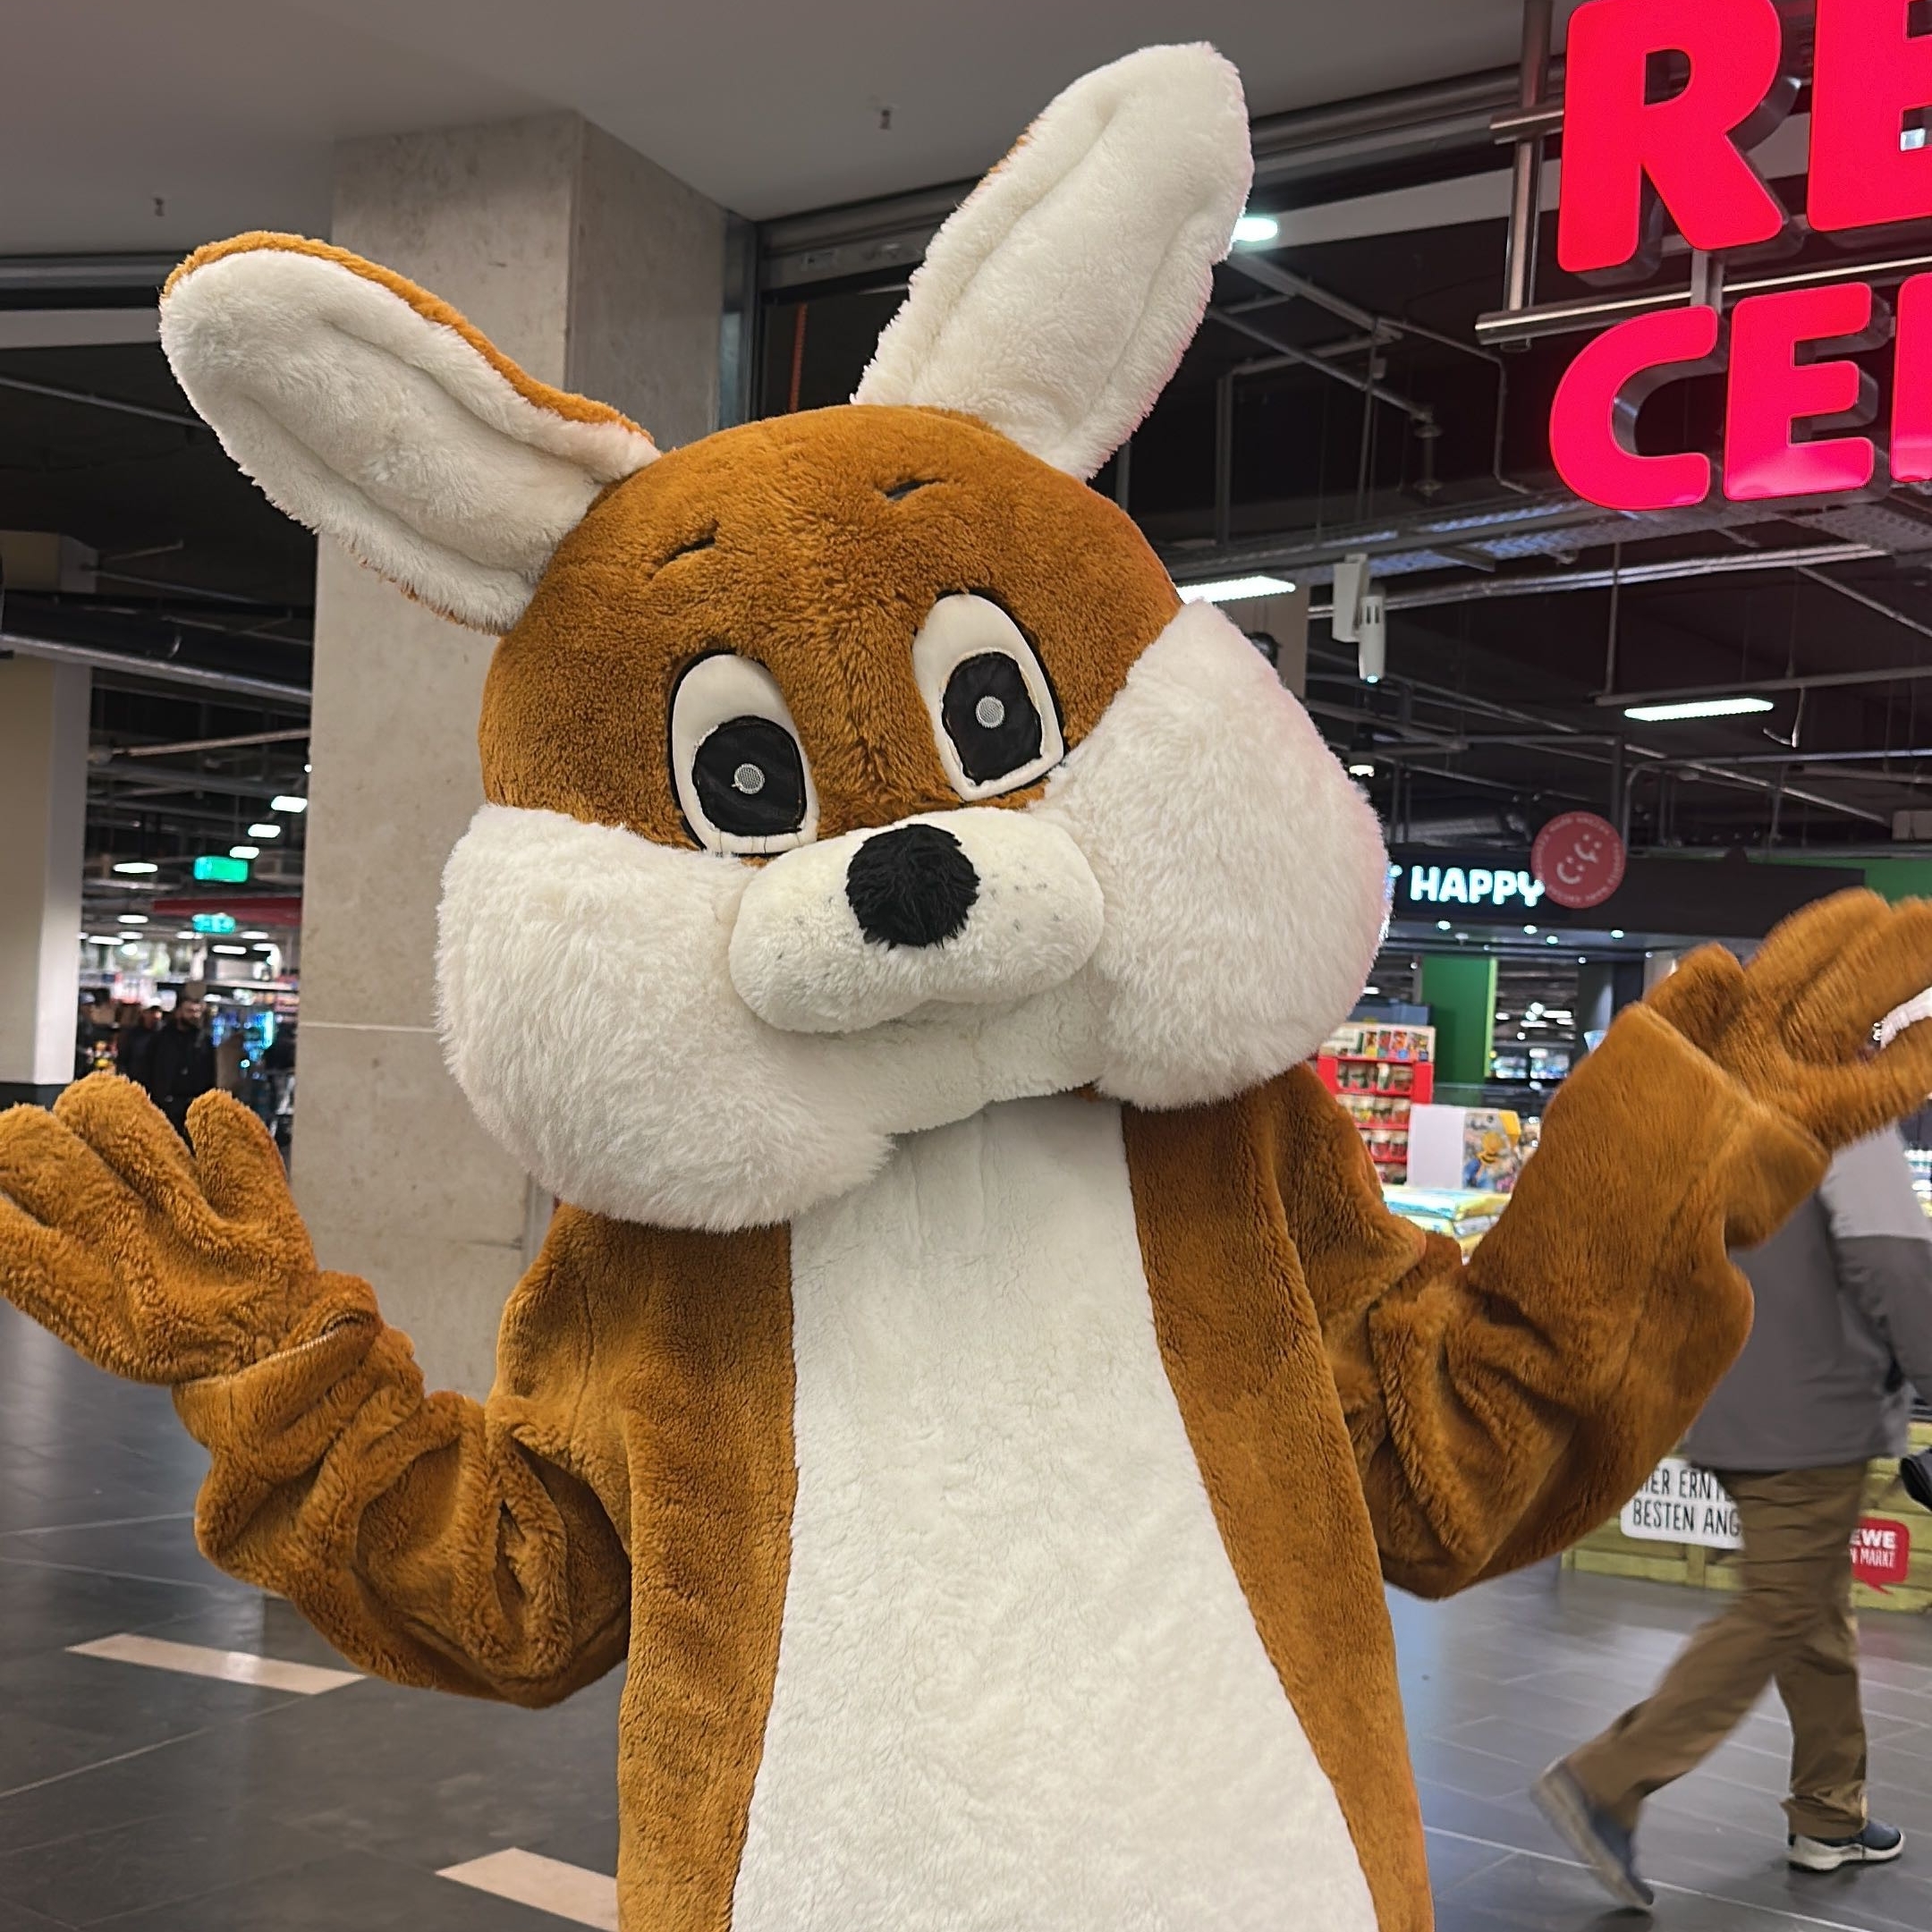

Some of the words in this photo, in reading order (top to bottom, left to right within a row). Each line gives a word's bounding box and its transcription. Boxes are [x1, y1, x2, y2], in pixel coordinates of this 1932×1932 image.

[1411, 865, 1546, 907] HAPPY
[1640, 1467, 1670, 1496] IER
[1679, 1470, 1732, 1503] ERN
[1633, 1499, 1694, 1531] BESTEN
[1860, 1548, 1894, 1568] MARKT
